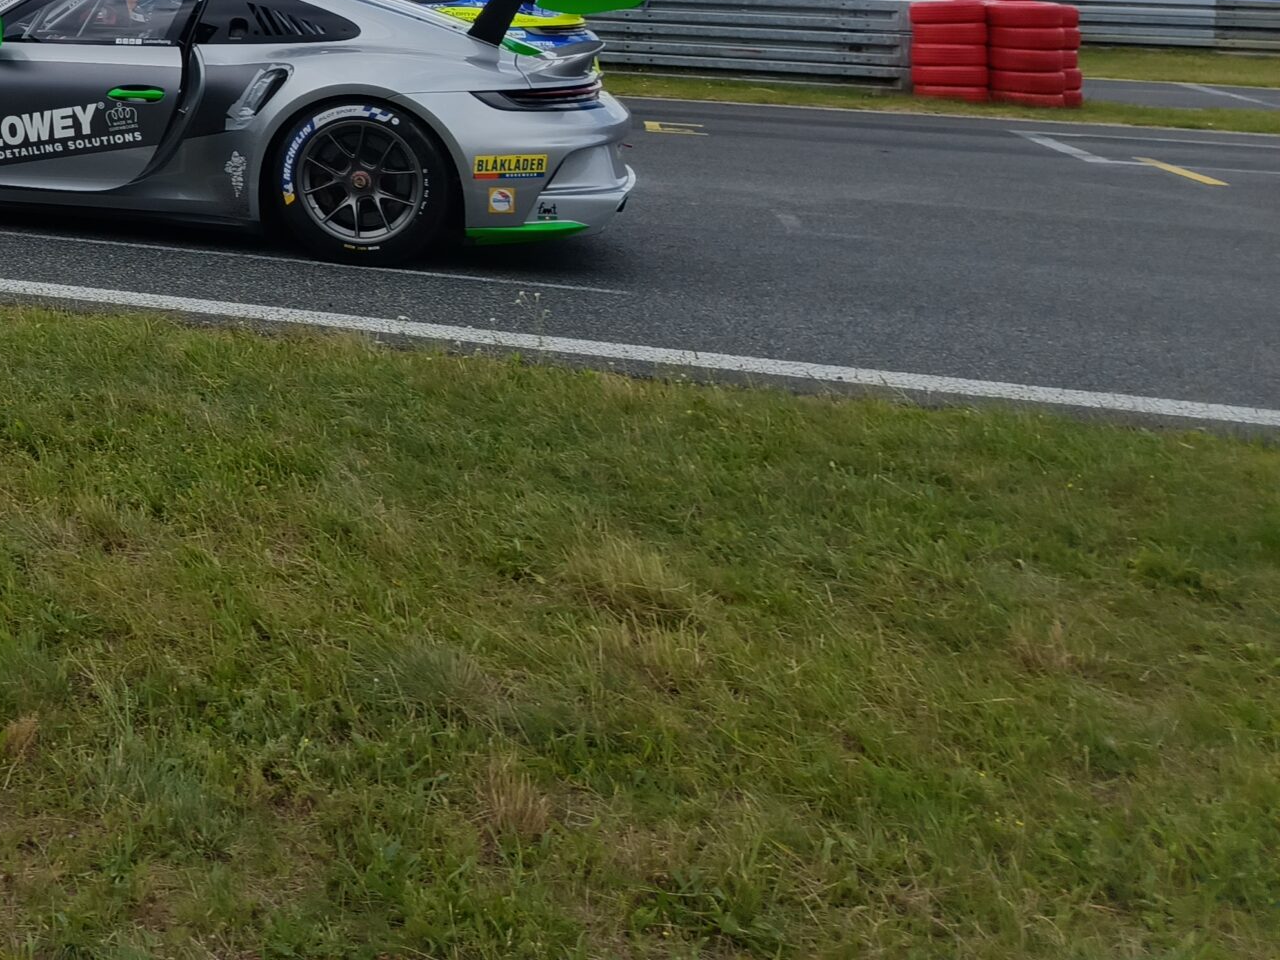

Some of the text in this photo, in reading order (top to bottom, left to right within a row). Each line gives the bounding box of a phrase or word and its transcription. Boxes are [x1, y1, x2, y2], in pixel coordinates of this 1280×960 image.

[67, 131, 142, 150] SOLUTIONS
[283, 124, 312, 182] MICHELIN
[476, 156, 545, 172] BLÅKLÄDER
